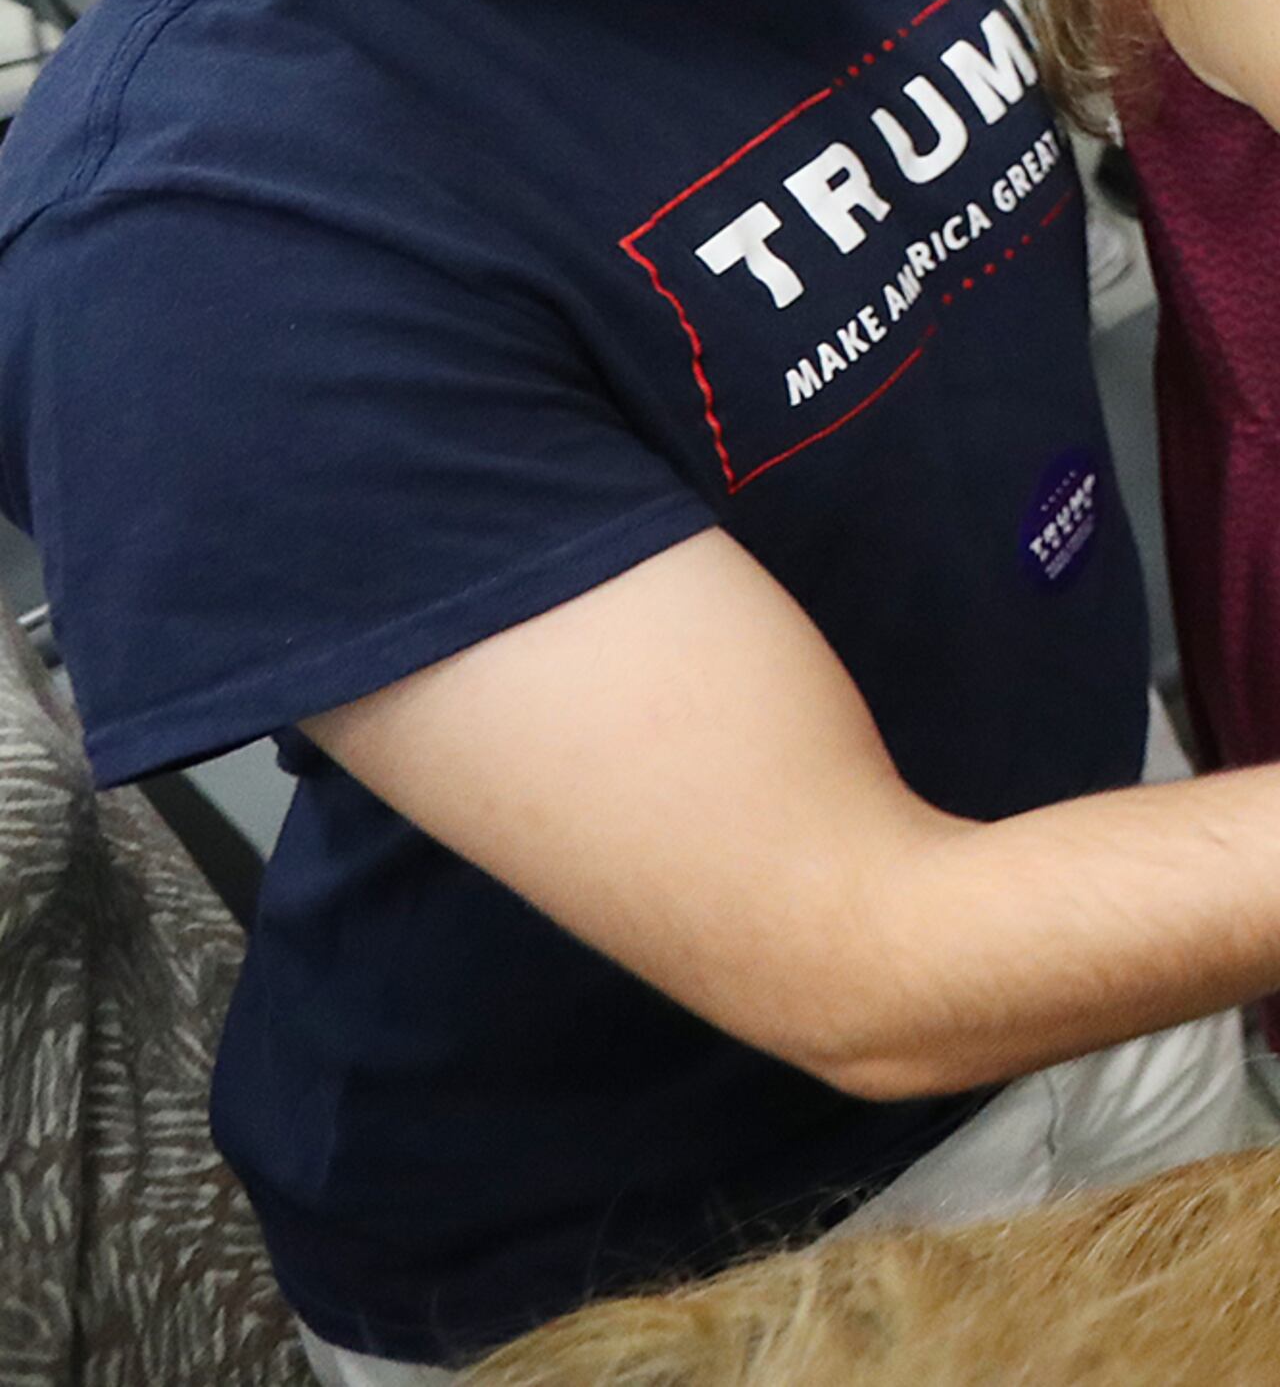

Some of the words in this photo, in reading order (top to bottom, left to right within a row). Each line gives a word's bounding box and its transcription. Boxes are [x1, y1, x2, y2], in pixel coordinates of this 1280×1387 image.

[785, 304, 888, 407] MAKE
[883, 202, 993, 322] AMRICA
[1029, 474, 1096, 563] TRUMP
